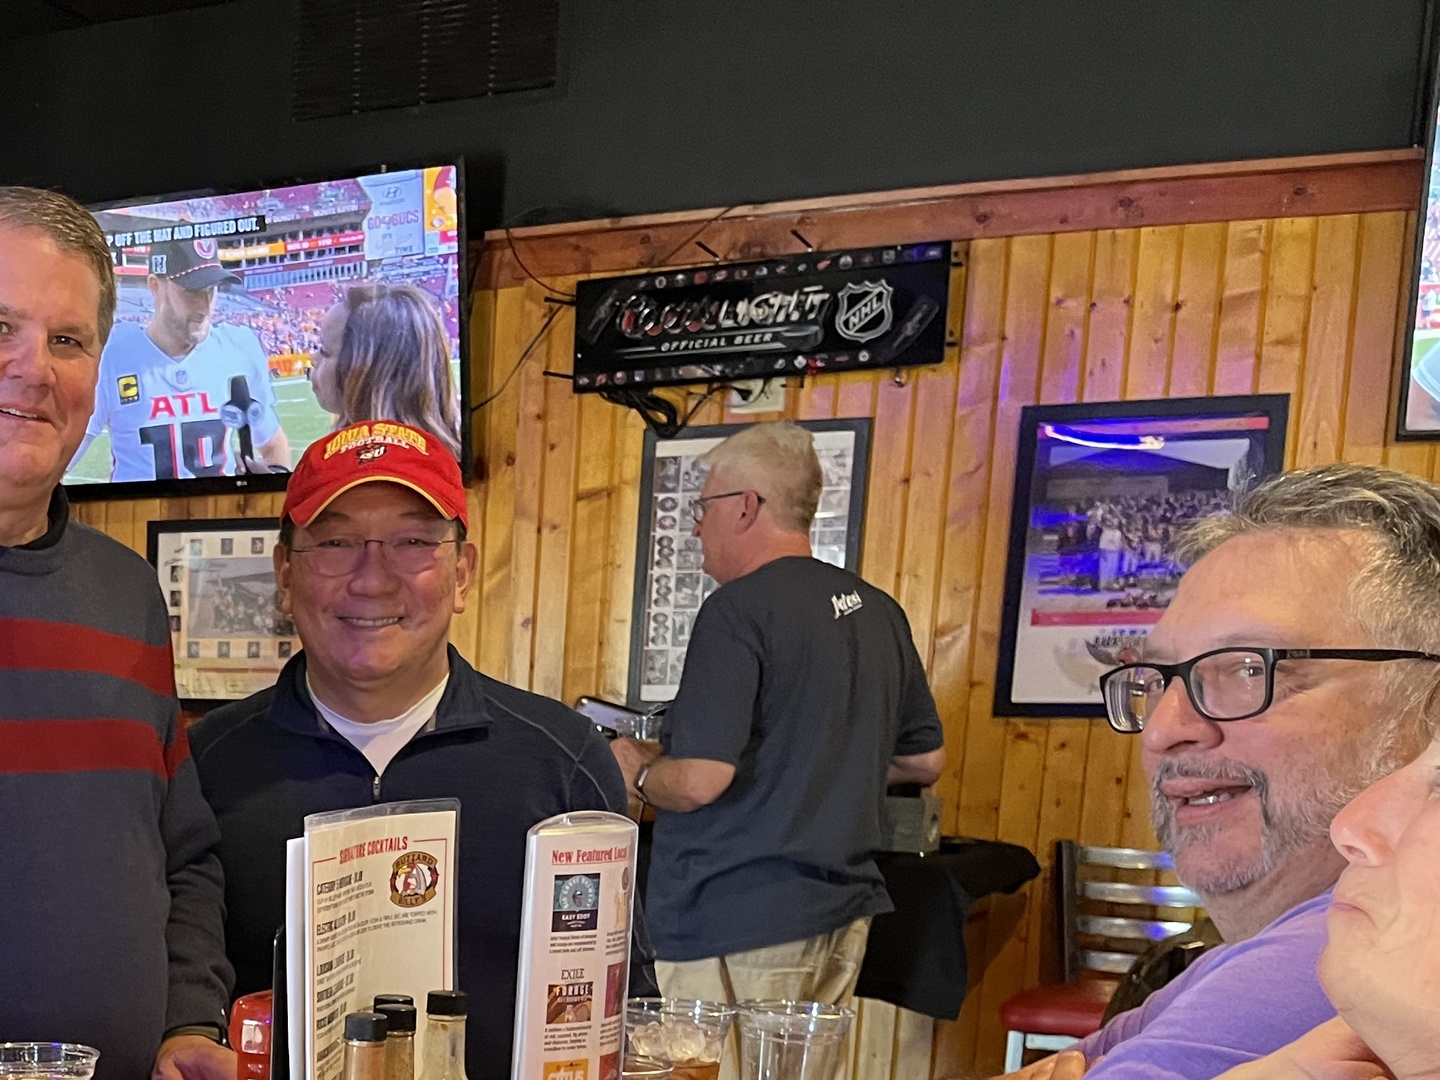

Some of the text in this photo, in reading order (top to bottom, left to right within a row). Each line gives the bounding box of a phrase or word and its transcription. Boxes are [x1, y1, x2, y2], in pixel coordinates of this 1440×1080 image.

[115, 231, 133, 247] OFF
[134, 230, 153, 245] THE
[173, 225, 193, 240] AND
[194, 219, 236, 237] FIGURED
[237, 217, 260, 232] OUT.
[848, 295, 883, 332] NHL
[661, 332, 773, 352] OFFICIAL BEER
[150, 391, 219, 420] ATL
[339, 436, 410, 454] FOOTBALL
[373, 423, 430, 456] STATE
[367, 836, 408, 857] COCKTAILS
[552, 850, 574, 864] New
[576, 848, 613, 863] Featured
[395, 852, 434, 868] BUZZARD
[561, 968, 585, 980] EXILE
